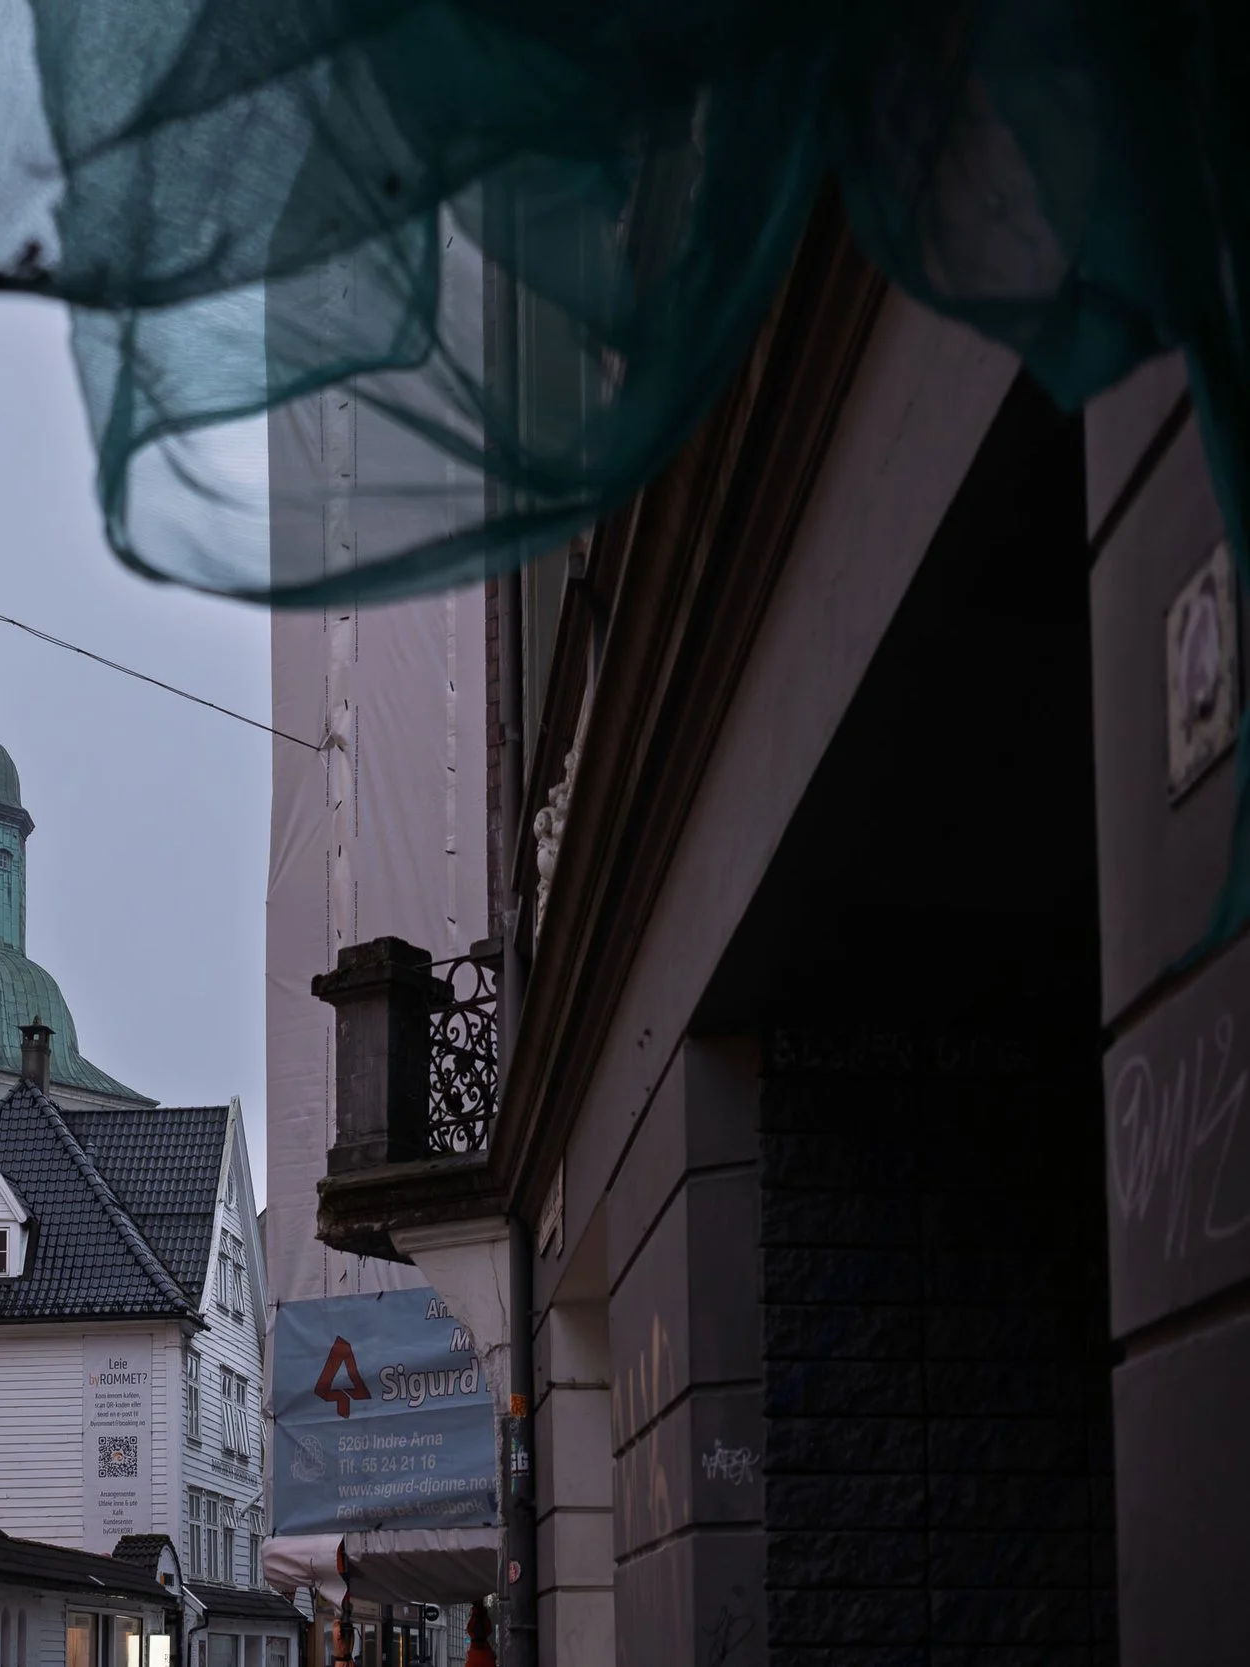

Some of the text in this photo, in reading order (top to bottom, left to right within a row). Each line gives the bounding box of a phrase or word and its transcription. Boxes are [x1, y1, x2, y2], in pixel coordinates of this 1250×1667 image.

[109, 1358, 127, 1370] Leie
[89, 1373, 147, 1388] byROMMET?
[379, 1357, 479, 1408] Sigurd
[338, 1431, 443, 1452] 5260 Indre Arna
[338, 1454, 436, 1474] Tlf. 55 24 21 16
[416, 1498, 485, 1515] facebook
